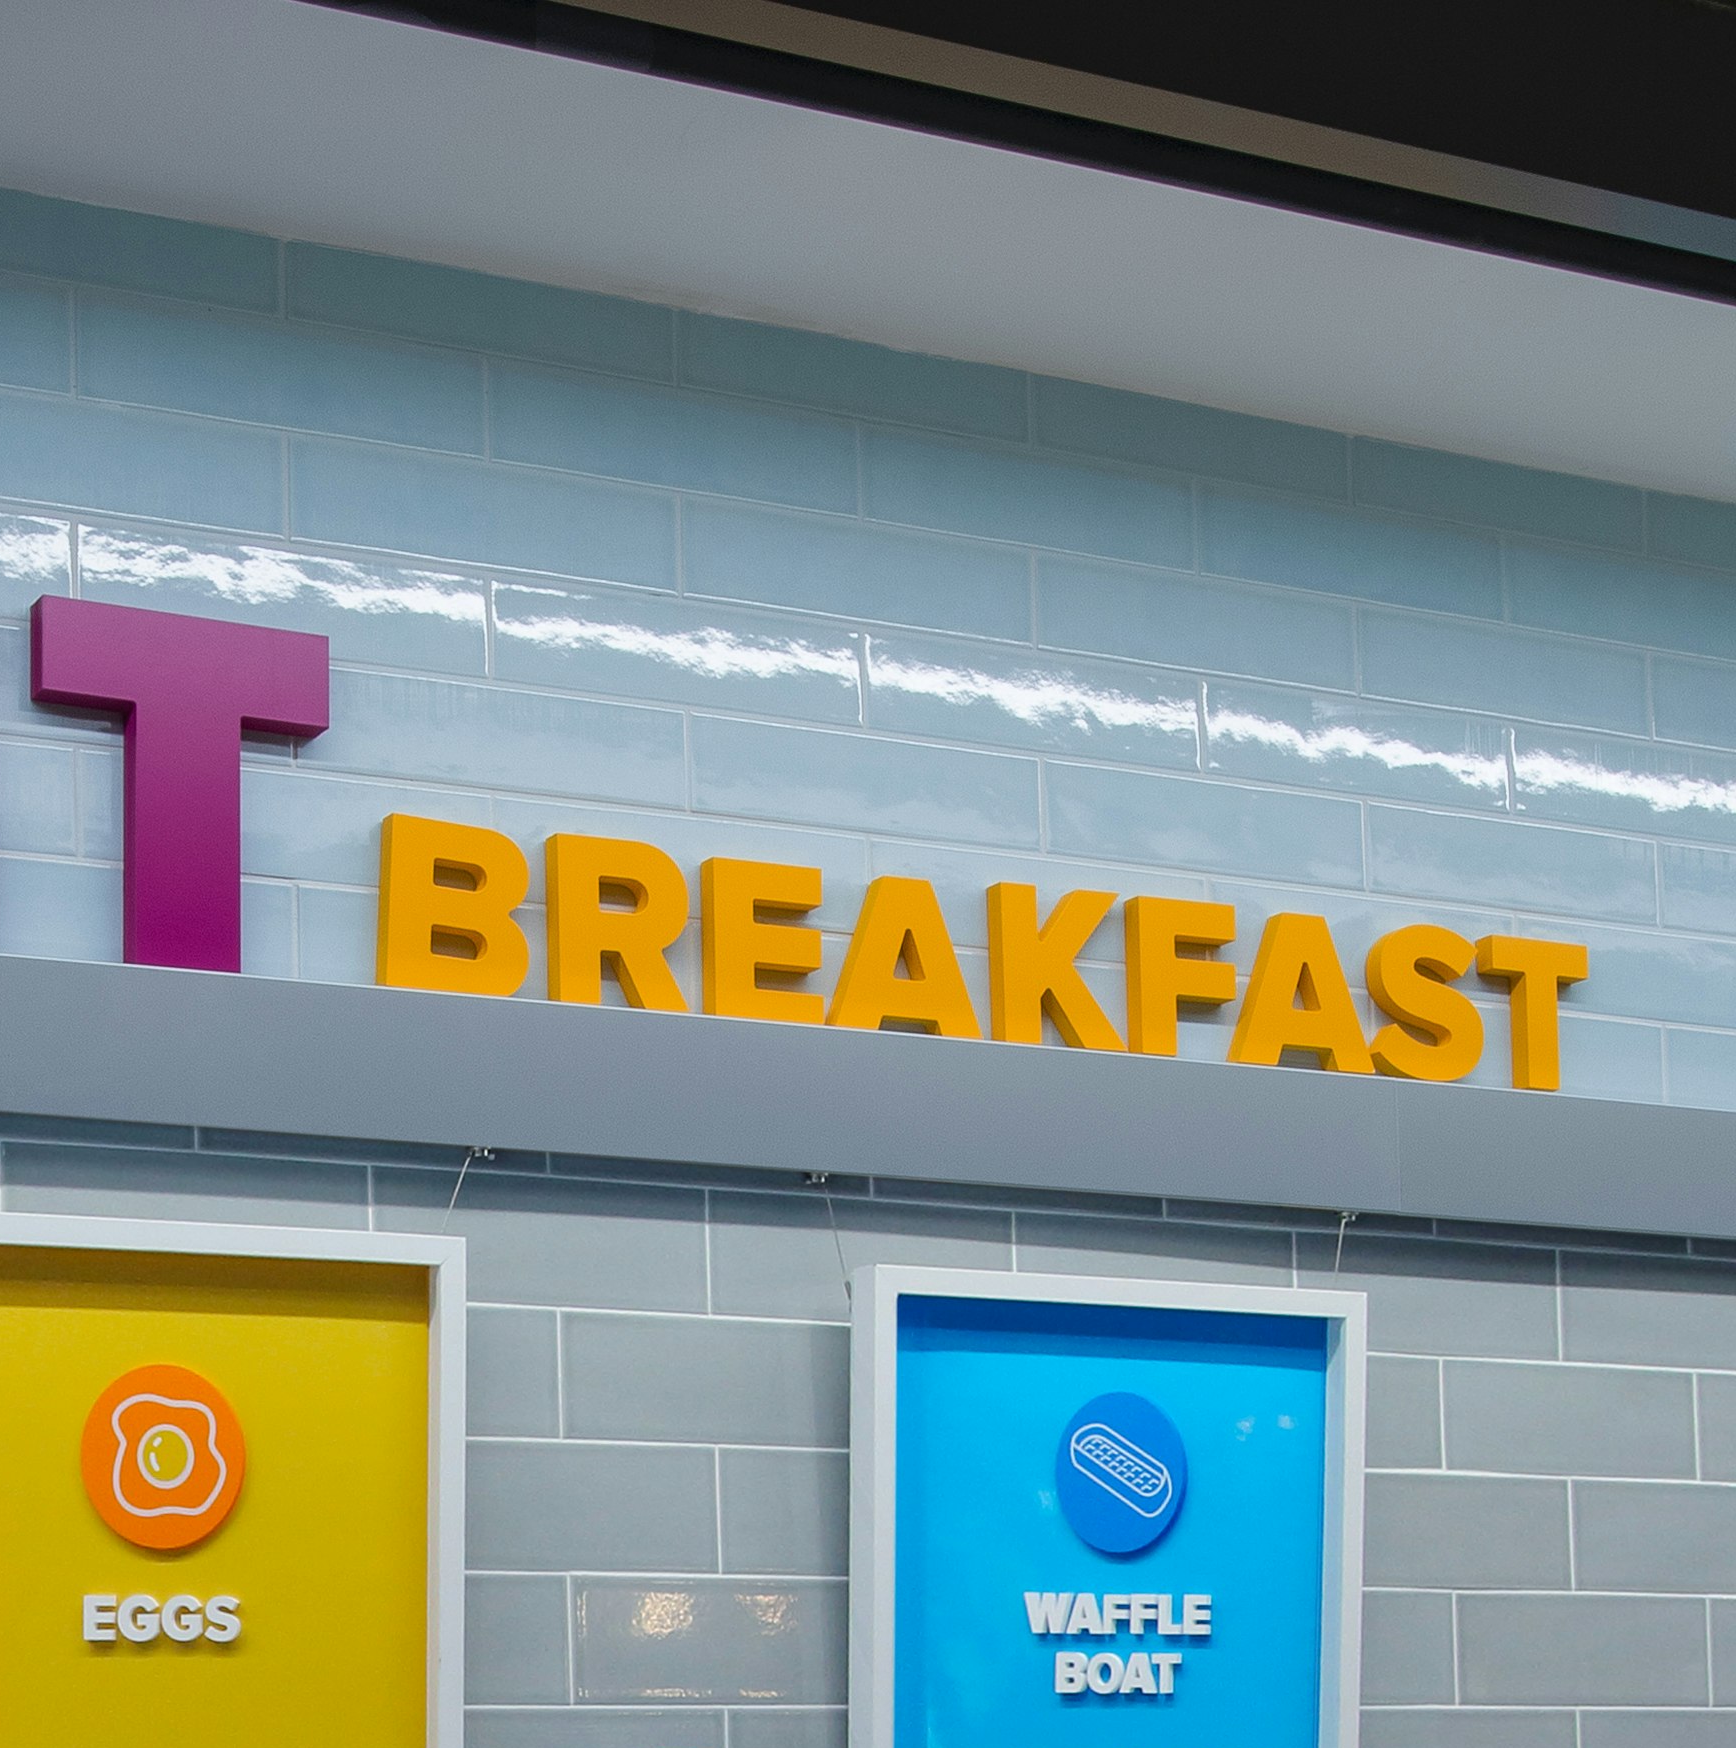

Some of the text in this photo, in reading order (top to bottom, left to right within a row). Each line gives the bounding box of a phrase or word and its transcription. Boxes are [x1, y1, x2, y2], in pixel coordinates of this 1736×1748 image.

[375, 813, 1589, 1092] BREAKFAST
[81, 1593, 242, 1644] EGGS
[1024, 1592, 1213, 1636] WAFFLE
[1055, 1652, 1182, 1696] BOAT
